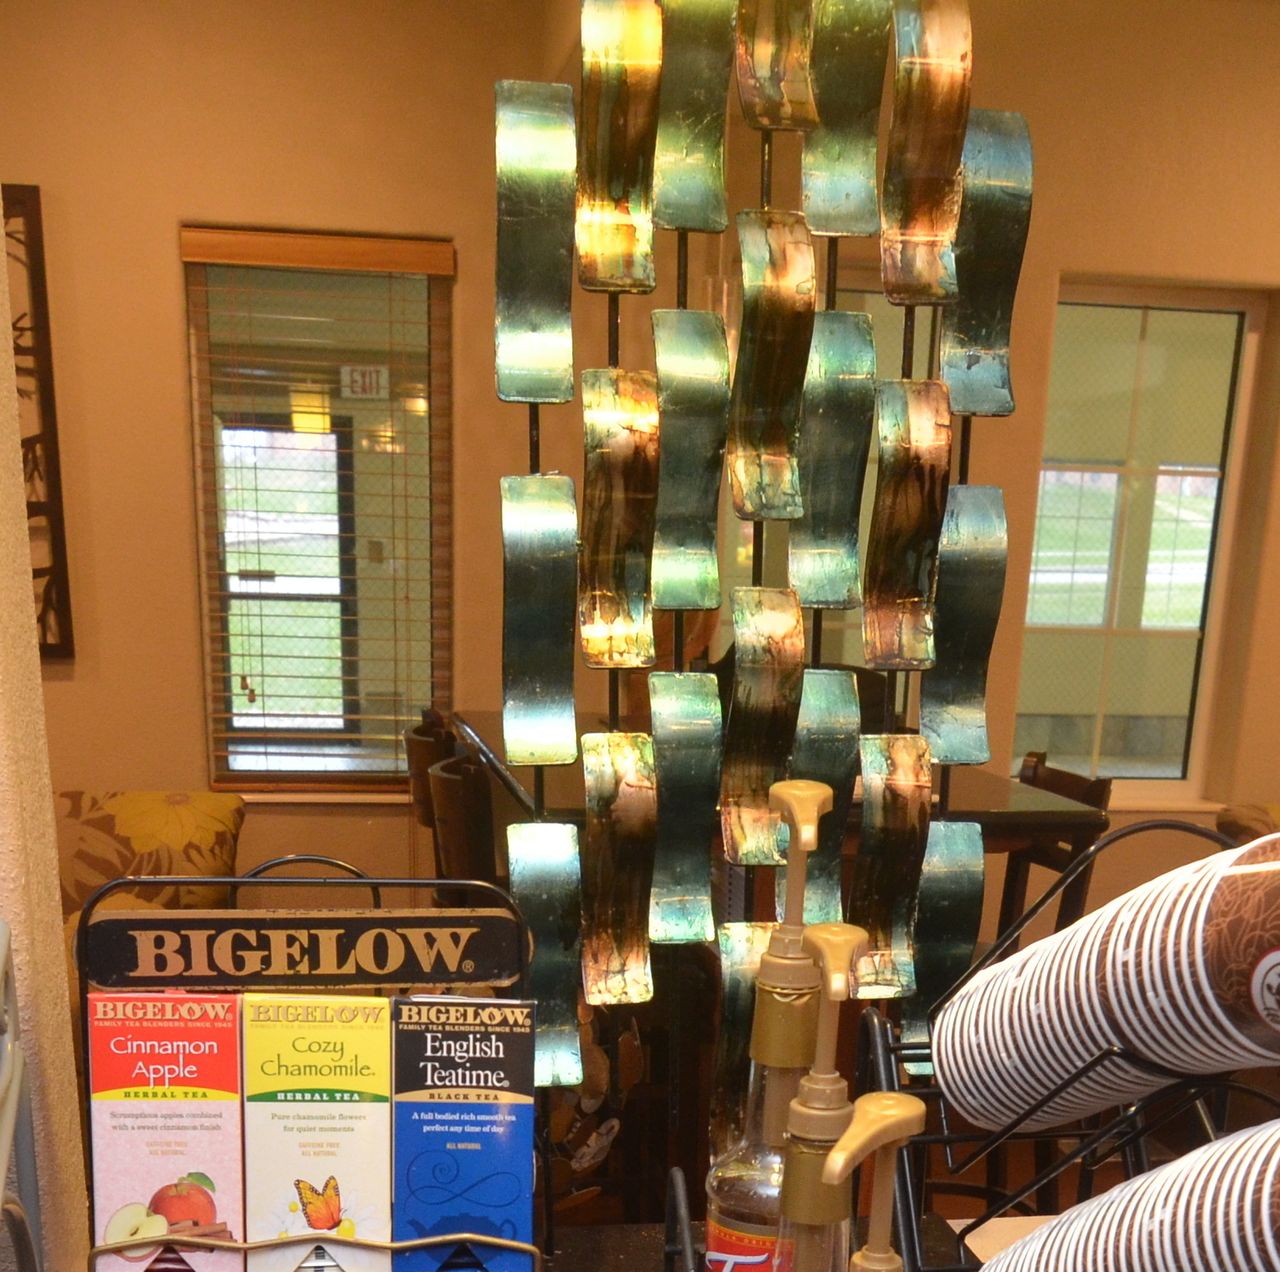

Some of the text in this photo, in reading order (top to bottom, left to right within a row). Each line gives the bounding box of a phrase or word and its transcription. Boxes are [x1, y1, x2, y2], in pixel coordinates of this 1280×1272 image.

[351, 368, 381, 395] EXIT
[128, 928, 480, 977] BIGELOW
[95, 1001, 232, 1020] BIGELOW
[250, 1005, 385, 1023] BIGELOW
[399, 1005, 531, 1025] BIGELOW
[110, 1034, 218, 1055] Cinnamon
[292, 1037, 344, 1062] Cozy
[424, 1033, 505, 1063] English
[132, 1053, 198, 1089] Apple
[419, 1061, 505, 1088] Teatime
[277, 1092, 329, 1100] HERBAL
[411, 1112, 419, 1120] A
[435, 1112, 460, 1120] bodied
[461, 1112, 476, 1120] rich
[464, 1124, 481, 1132] time
